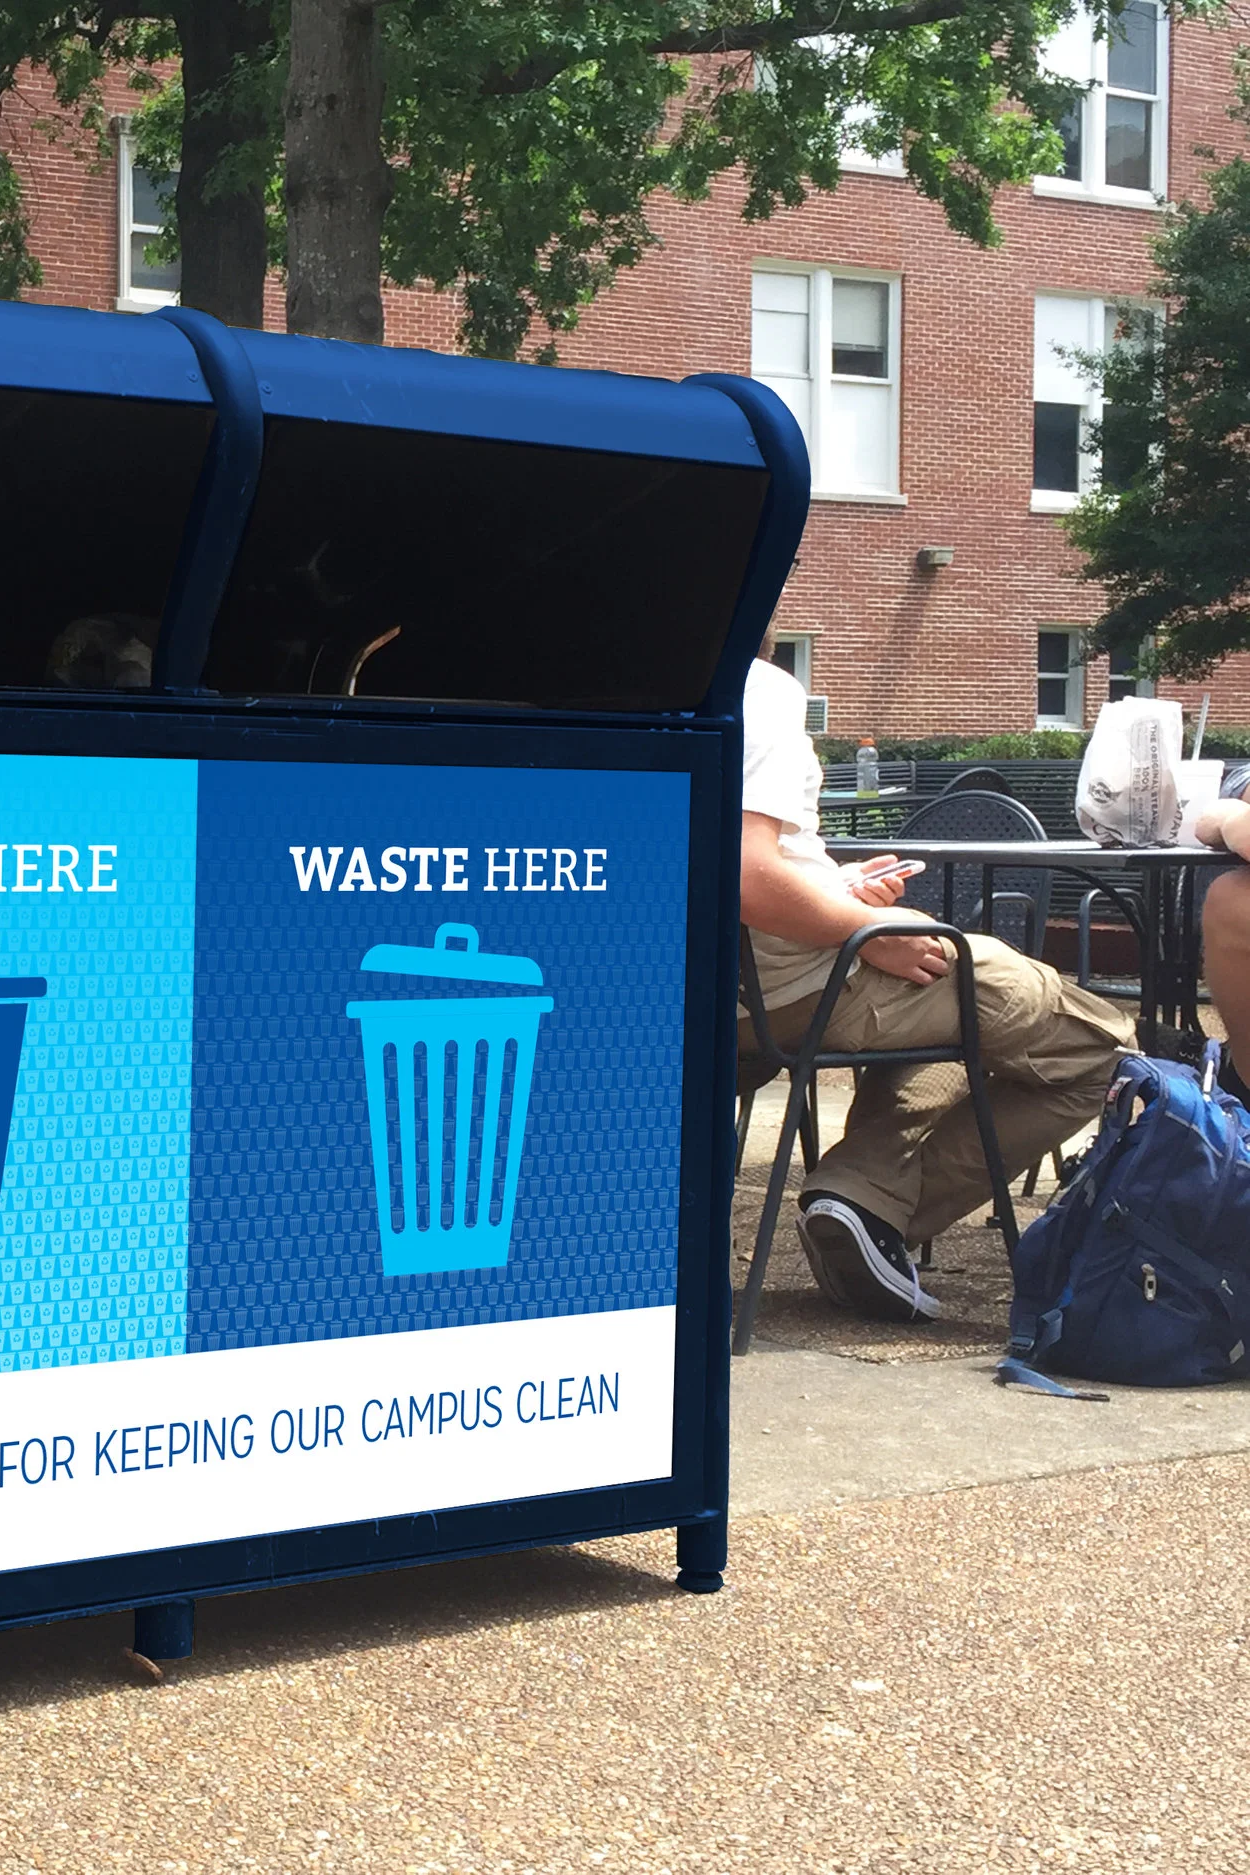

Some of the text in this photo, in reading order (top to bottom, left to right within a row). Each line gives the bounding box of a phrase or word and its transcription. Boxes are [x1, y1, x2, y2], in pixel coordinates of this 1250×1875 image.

[1150, 725, 1158, 743] THE
[1141, 766, 1150, 792] 100%
[1150, 745, 1159, 790] ORIGINAL
[289, 846, 607, 893] WASTE HERE
[94, 1413, 255, 1476] KEEPING
[270, 1404, 345, 1454] OUR
[361, 1385, 503, 1443] CAMPUS
[516, 1372, 620, 1424] CLEAN
